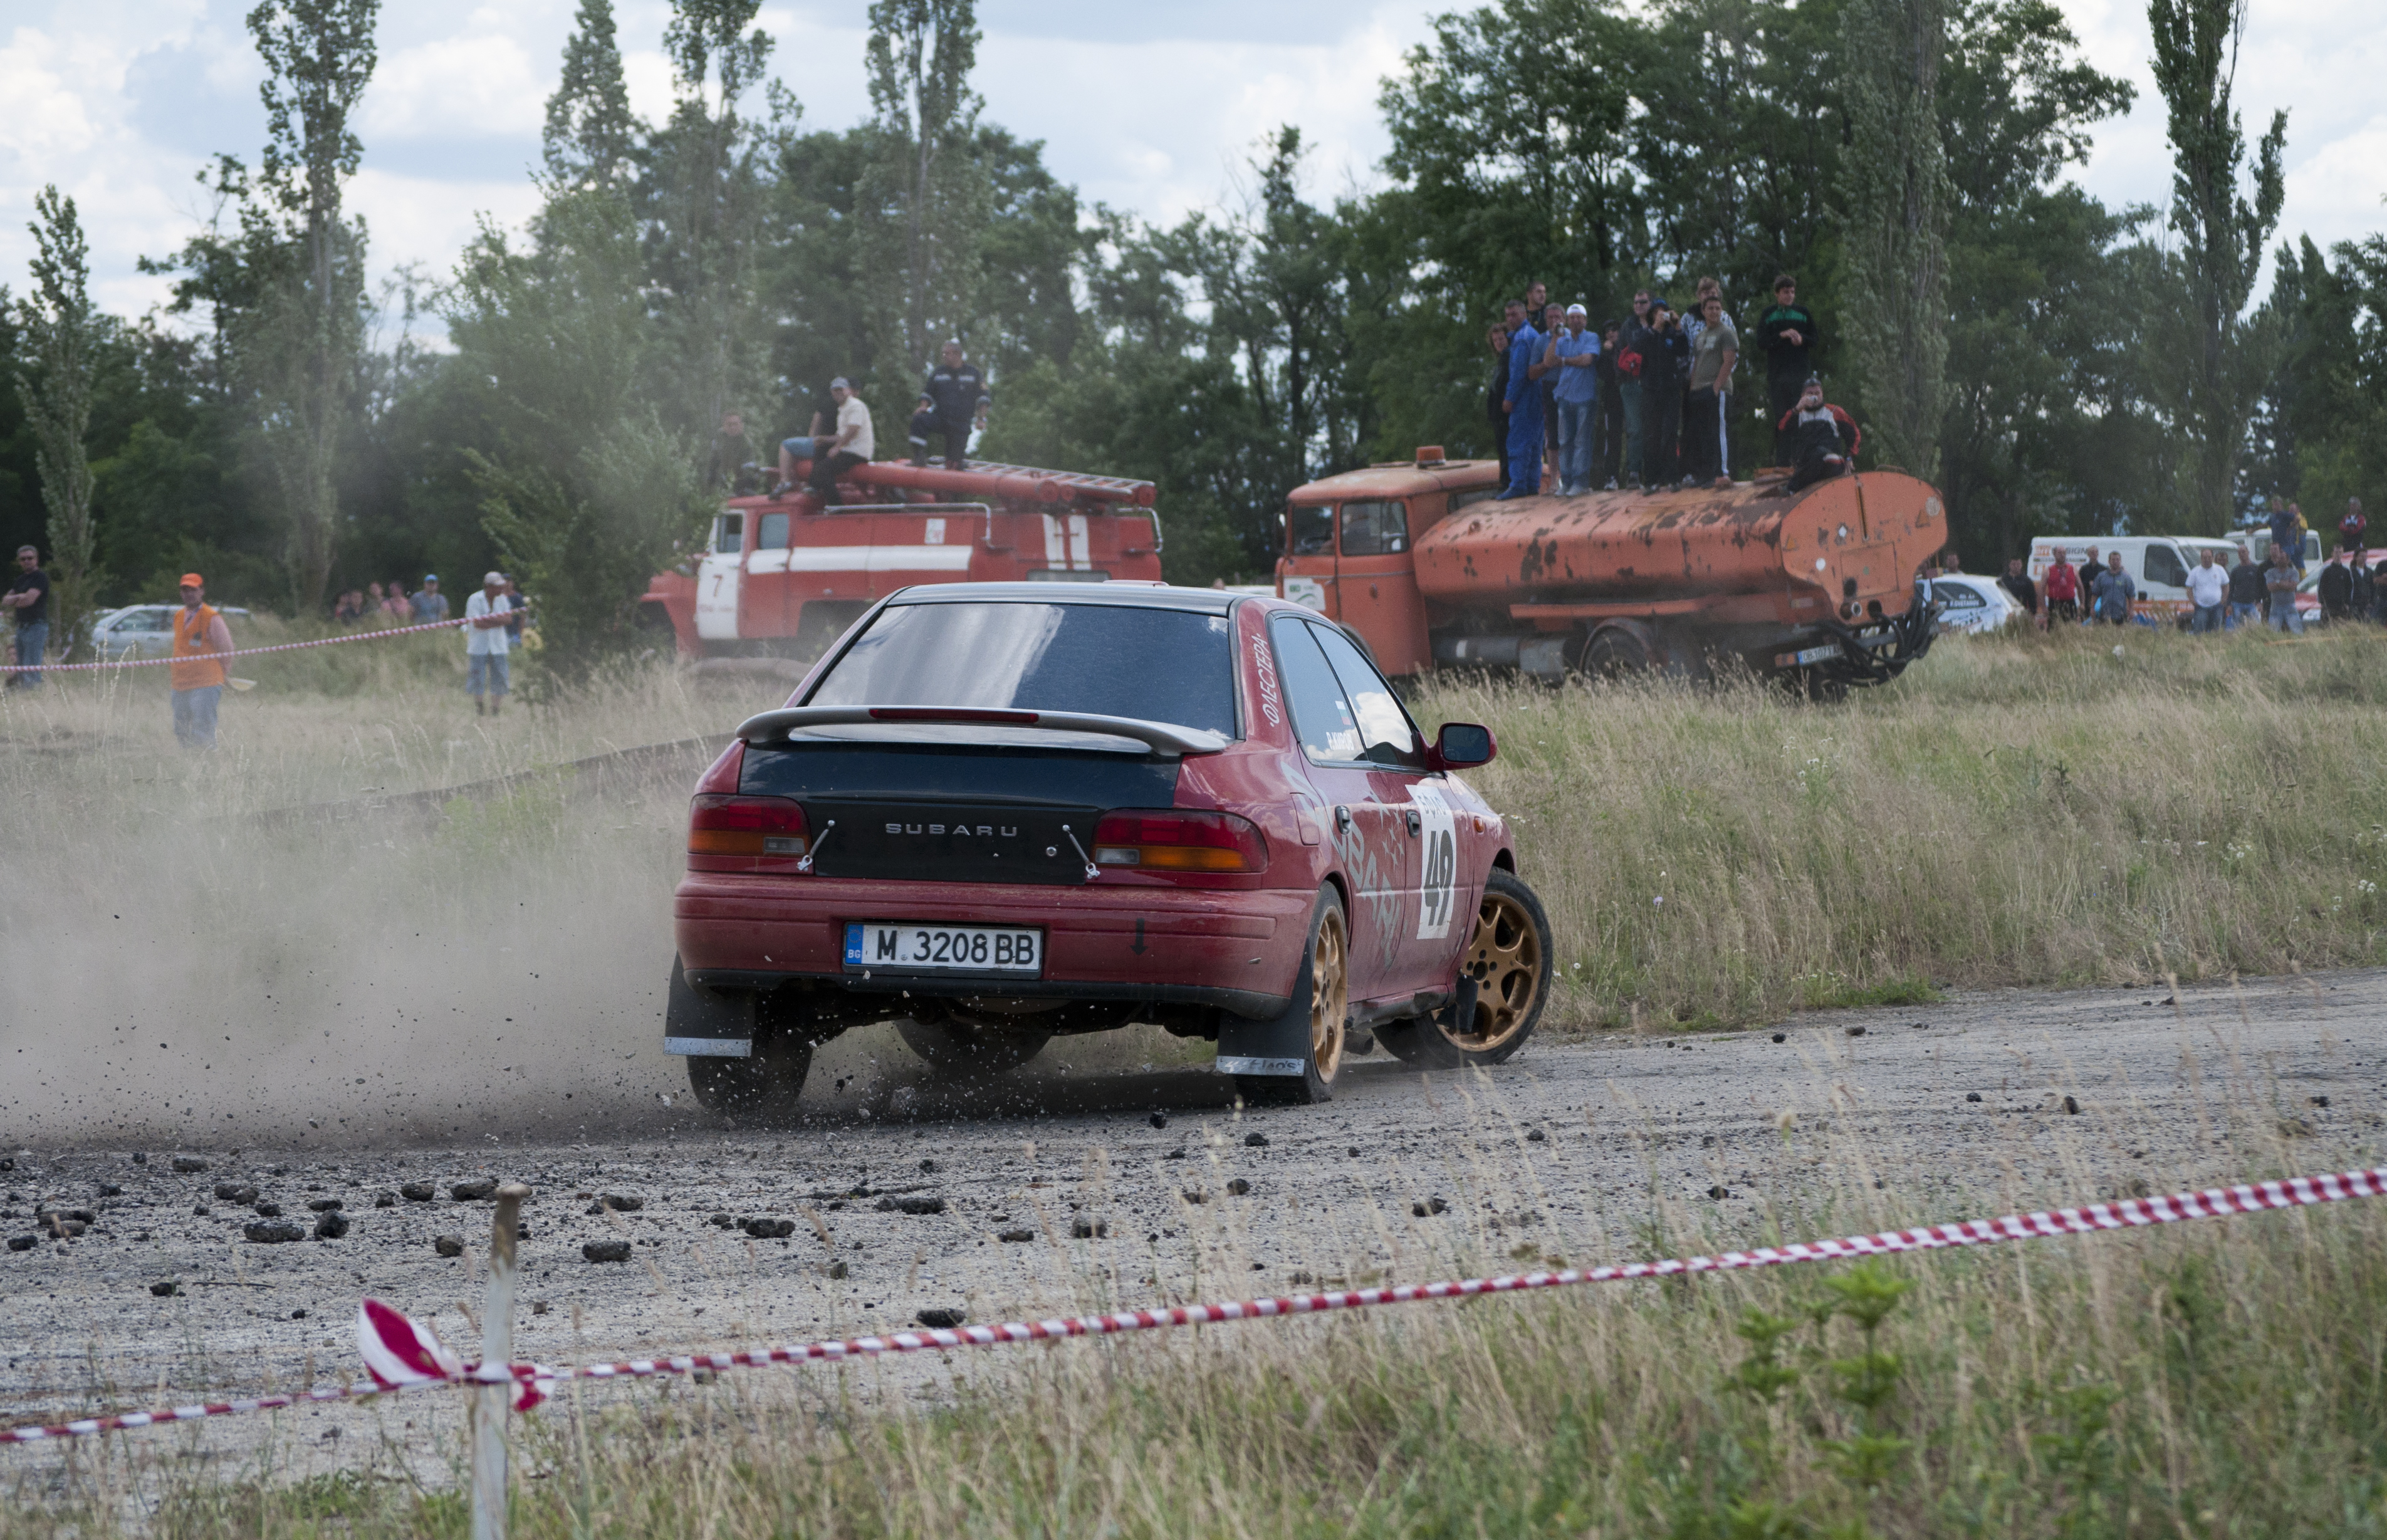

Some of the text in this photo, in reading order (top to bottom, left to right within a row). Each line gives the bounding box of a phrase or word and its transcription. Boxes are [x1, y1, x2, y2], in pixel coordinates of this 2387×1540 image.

[713, 574, 723, 598] 7
[885, 823, 1017, 837] SUBARU
[1424, 830, 1453, 925] 49
[847, 949, 861, 959] BG
[877, 930, 1034, 965] M 3208 BB
